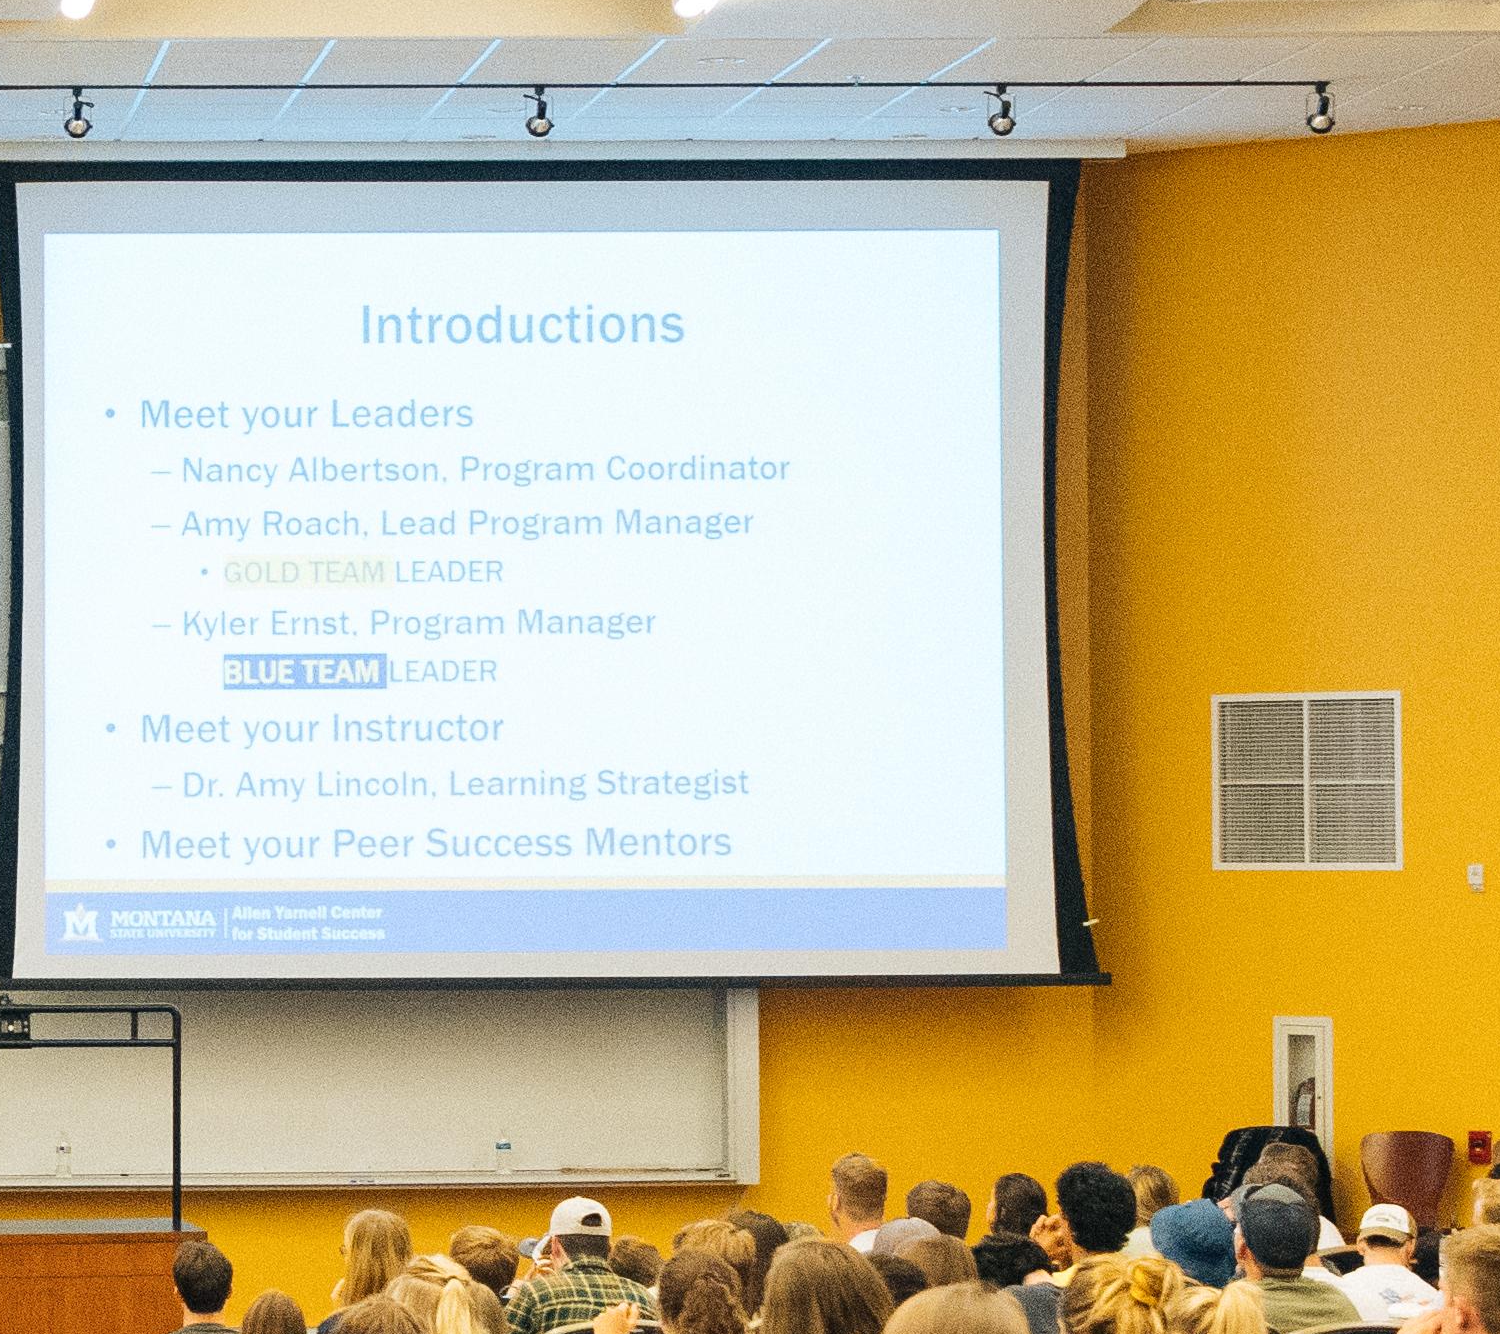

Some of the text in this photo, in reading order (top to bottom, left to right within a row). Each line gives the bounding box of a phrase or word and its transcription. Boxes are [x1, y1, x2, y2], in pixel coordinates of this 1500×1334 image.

[362, 304, 685, 344] Introductions
[141, 399, 473, 435] Meet your Leaders
[183, 455, 790, 488] Nancy Albertson, Program Coordinator
[182, 509, 754, 542] Amy Roach, Lead Program Manager
[224, 561, 503, 583] GOLD TEAM LEADER
[183, 609, 656, 641] Kyler Ernst, Program Manager
[224, 660, 497, 684] BLUE TEAM LEADER
[142, 713, 504, 749] Meet your Instructor
[183, 770, 749, 802] Dr. Amy Lincoln, Learning Strategist
[142, 828, 732, 865] Meet your Peer Success Mentors
[111, 910, 216, 927] MONTANA
[232, 906, 382, 920] Allen Yarnell Center
[111, 928, 216, 938] STATE UNIVERSITY
[232, 927, 385, 941] for Student Success
